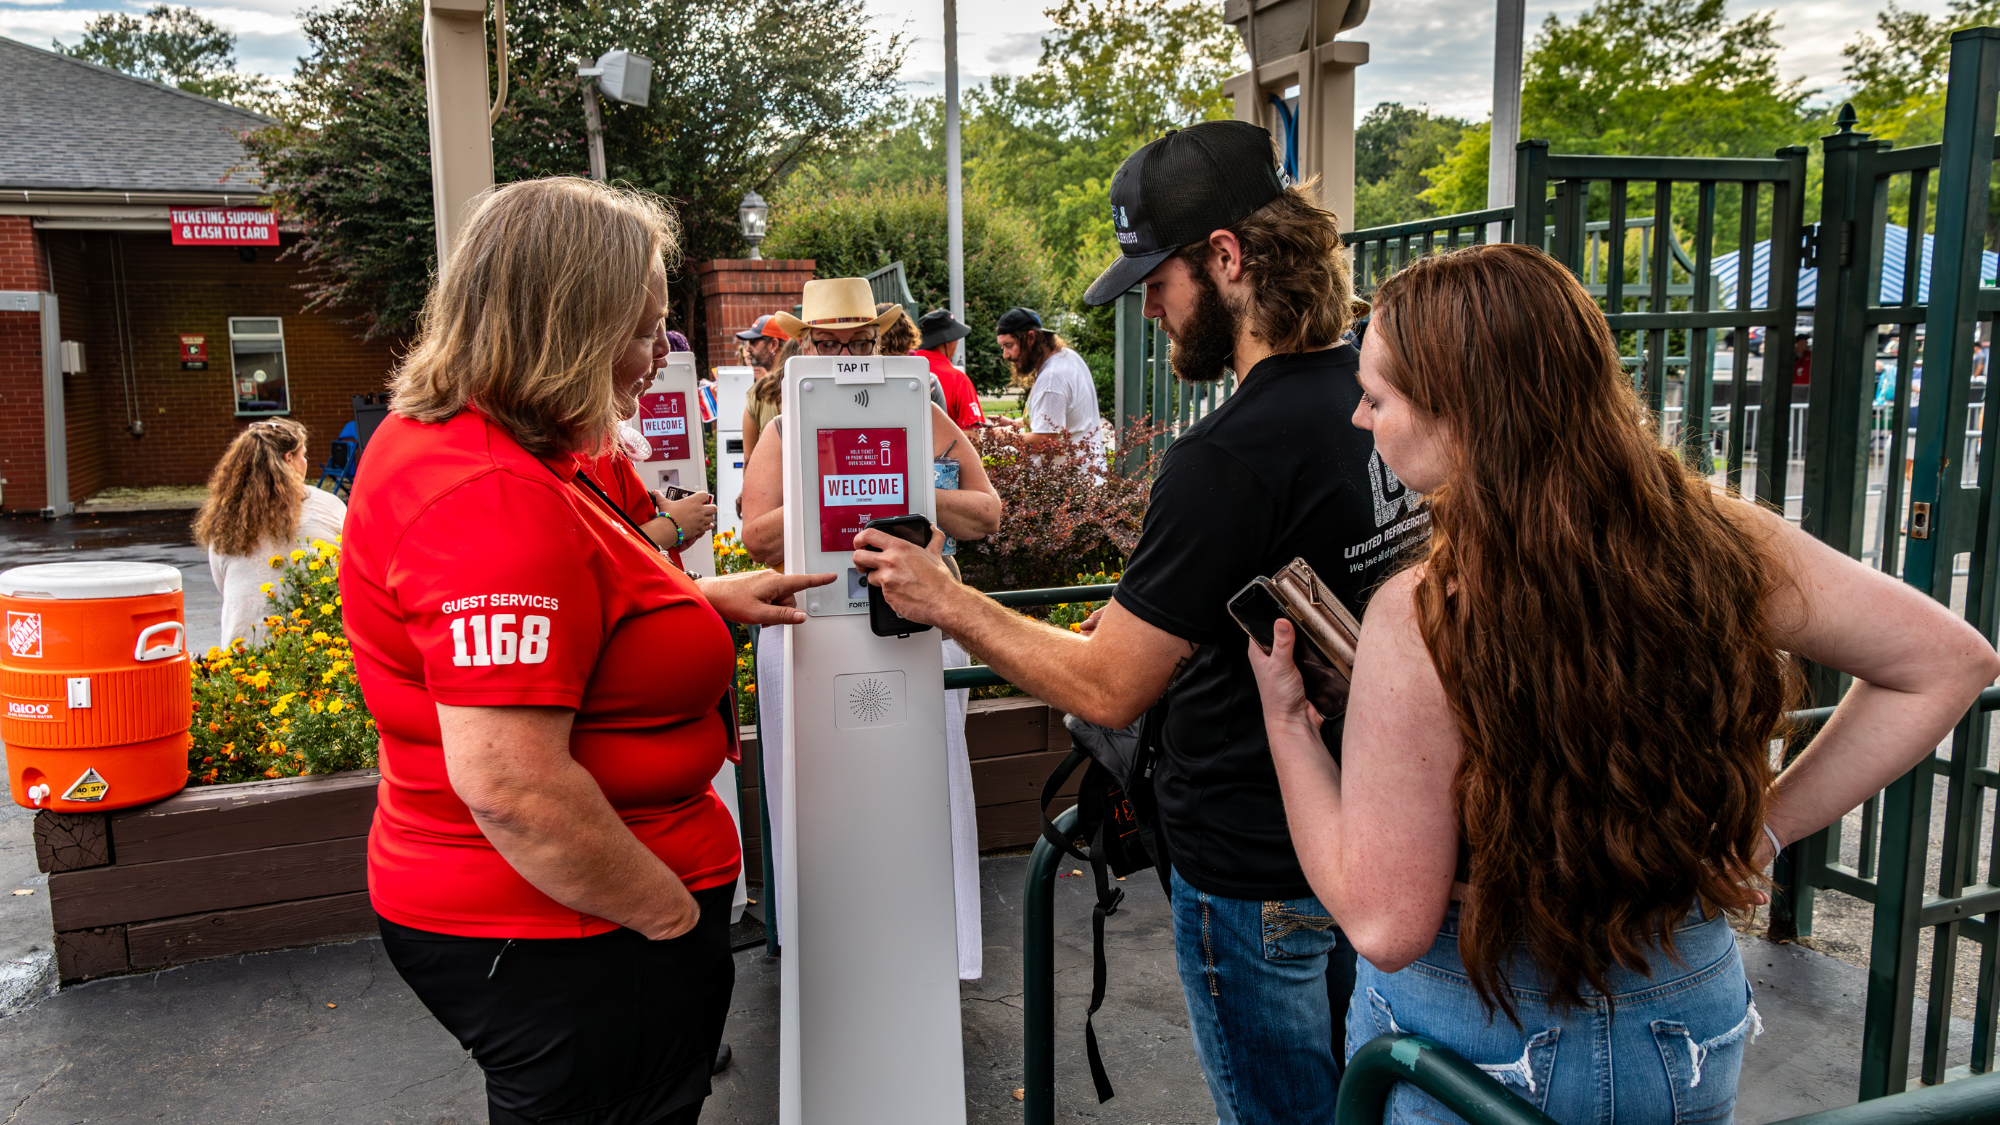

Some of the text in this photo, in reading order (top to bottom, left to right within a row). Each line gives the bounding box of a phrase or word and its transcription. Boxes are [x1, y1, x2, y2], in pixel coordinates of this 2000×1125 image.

[172, 210, 275, 225] TICKETING SUPPORT
[182, 225, 269, 239] & CASH TO CARD
[837, 363, 870, 372] TAP IT
[645, 419, 683, 431] WELCOME
[827, 478, 899, 496] WELCOME
[1349, 562, 1364, 573] We
[1365, 556, 1377, 569] have
[1389, 545, 1400, 559] your
[442, 593, 559, 614] GUEST SERVICES
[10, 615, 39, 653] HOME
[11, 618, 22, 634] THE
[19, 630, 40, 655] DEPOT
[449, 613, 551, 667] 1168
[8, 701, 49, 715] IGLOO
